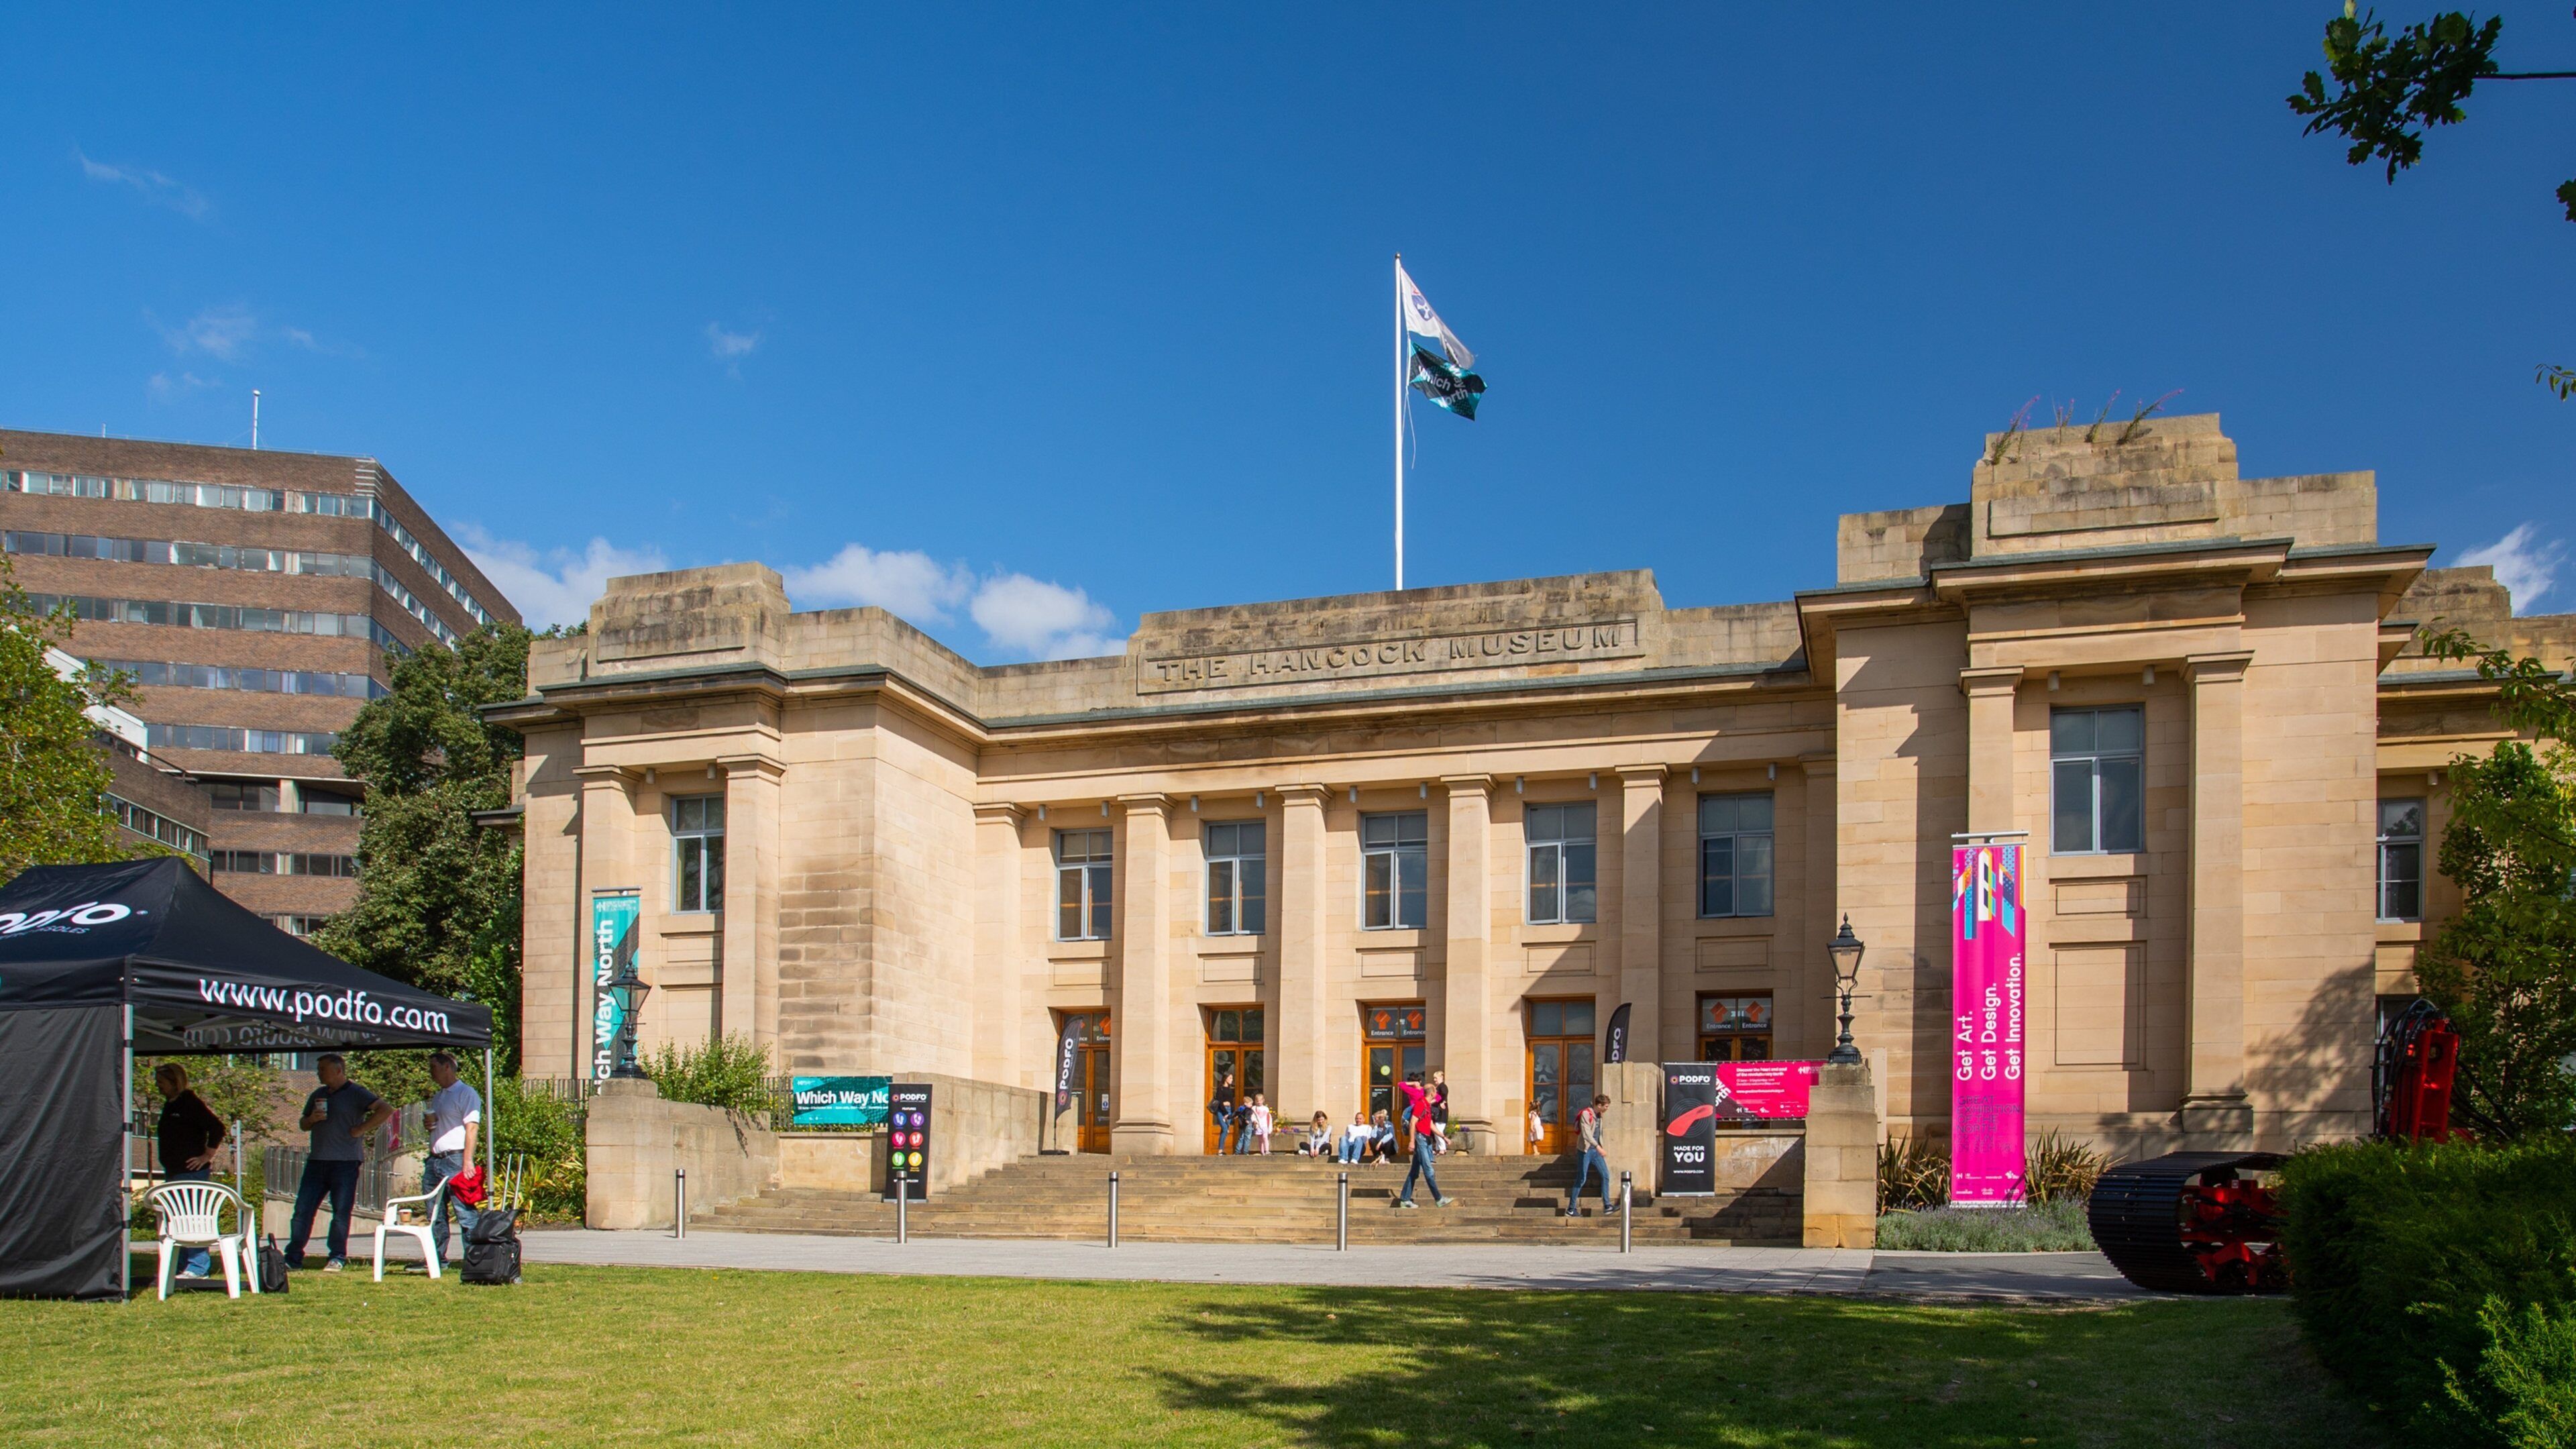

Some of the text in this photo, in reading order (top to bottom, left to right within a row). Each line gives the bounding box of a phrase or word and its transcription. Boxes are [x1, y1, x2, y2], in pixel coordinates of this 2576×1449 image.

[1157, 627, 1619, 682] THE HANCOCK MUSEUM
[199, 979, 450, 1034] www.podfo.com
[594, 920, 616, 1095] ich Way North
[2004, 953, 2021, 1080] Get Innovation.
[1612, 1028, 1621, 1063] DFO
[1957, 1011, 1972, 1081] Get Art.
[1980, 983, 2001, 1080] Get Design.
[1059, 1038, 1073, 1090] PODFO
[796, 1090, 837, 1104] Which
[839, 1091, 869, 1106] Way
[1957, 1095, 1994, 1105] GREAT
[1957, 1105, 2021, 1114] EXHIBITION
[1957, 1114, 1998, 1124] OF THE
[1957, 1124, 1996, 1133] NORTH
[1674, 1152, 1705, 1163] YOU
